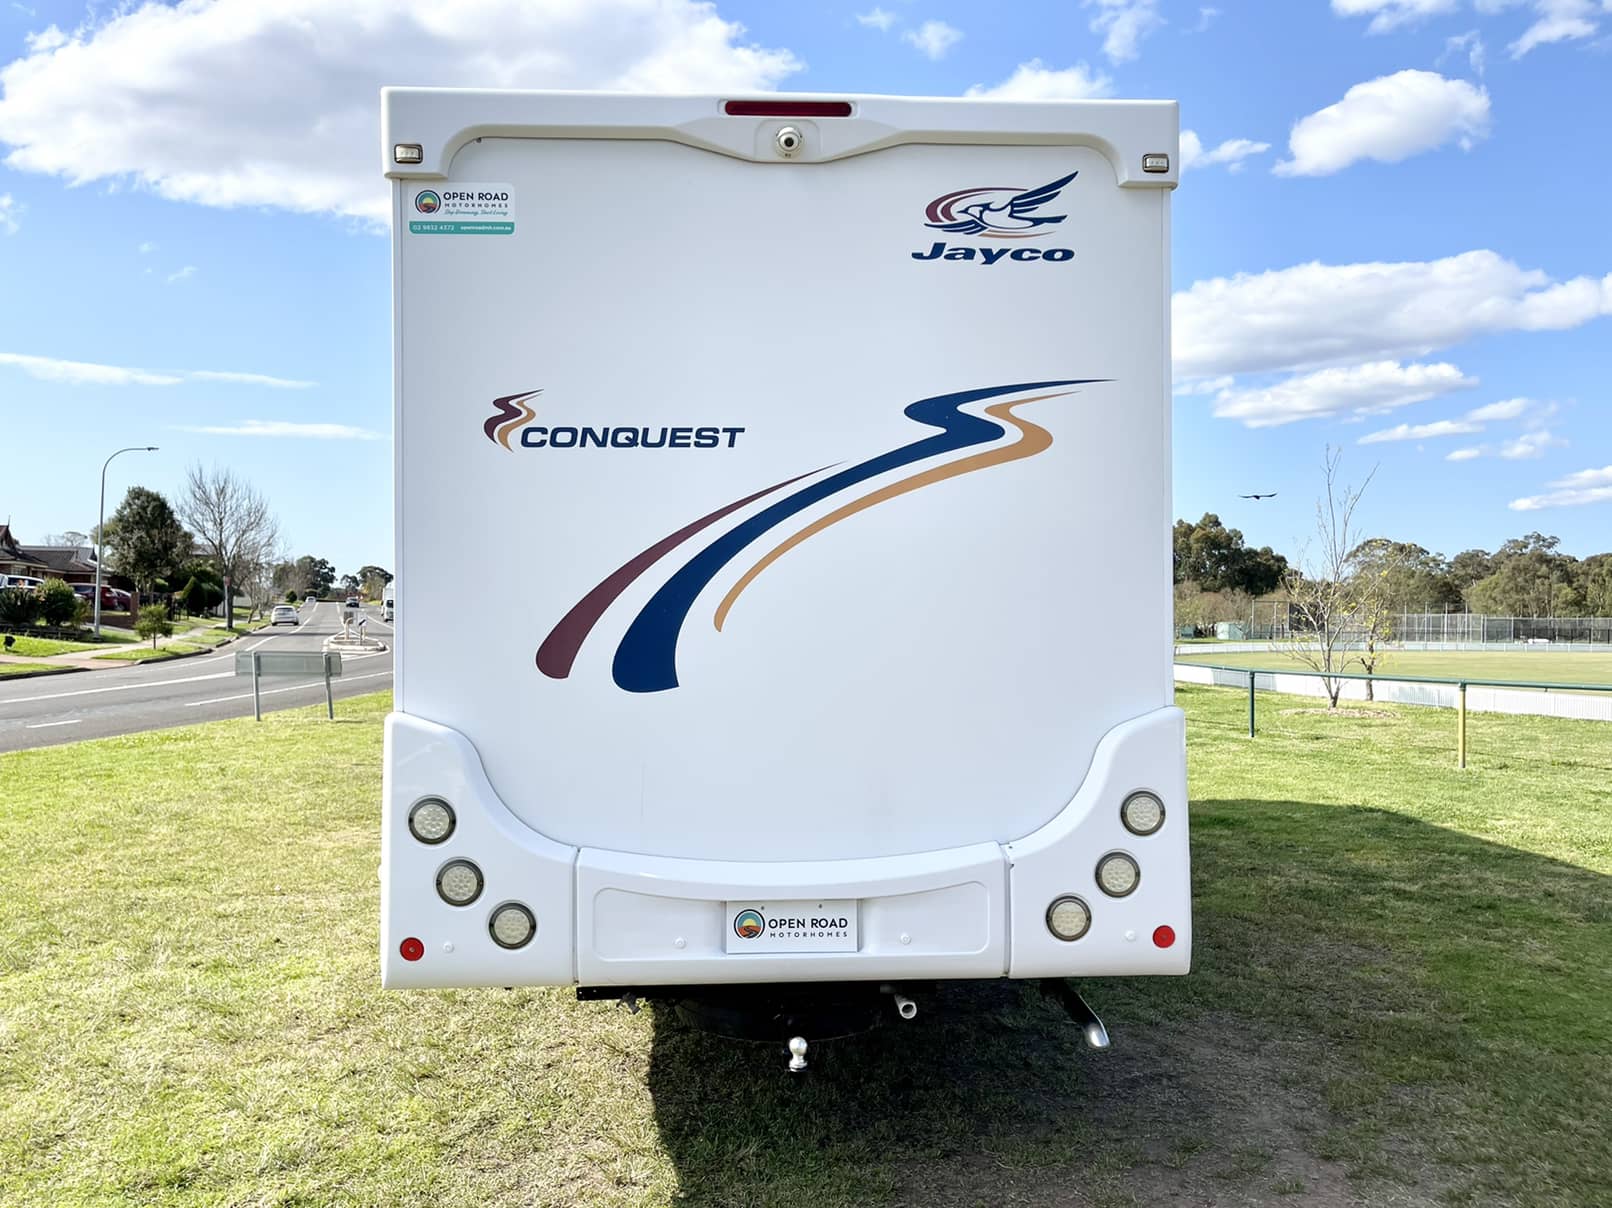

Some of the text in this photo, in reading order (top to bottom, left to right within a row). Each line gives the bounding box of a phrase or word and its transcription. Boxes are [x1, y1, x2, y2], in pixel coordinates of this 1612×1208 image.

[443, 192, 509, 201] OPEN ROAD
[911, 242, 1075, 265] Jayco
[520, 427, 746, 448] CONQUEST
[768, 917, 848, 929] OPEN ROAD
